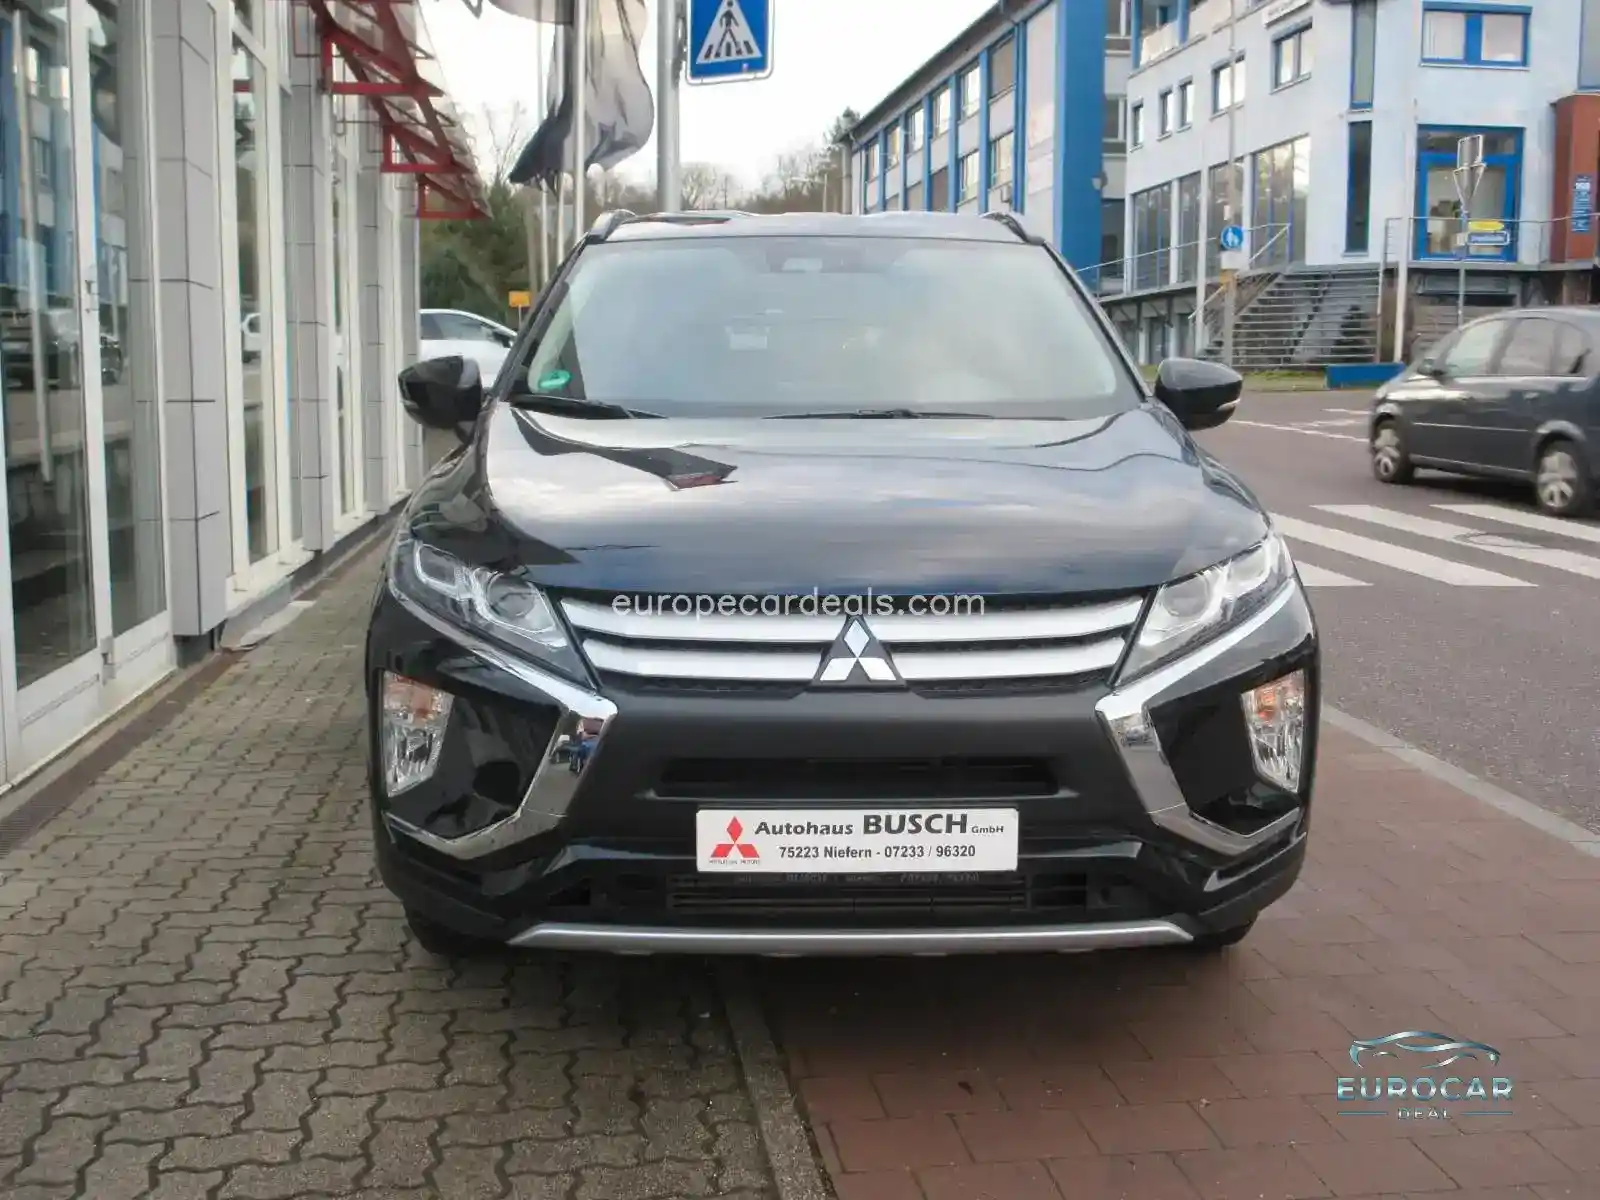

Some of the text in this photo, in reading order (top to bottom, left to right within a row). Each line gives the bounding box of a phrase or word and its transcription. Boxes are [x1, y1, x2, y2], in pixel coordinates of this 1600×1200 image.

[754, 813, 1004, 836] Autohaus BUSCH GmbH
[779, 846, 819, 859] 75223
[824, 846, 872, 859] Niefern
[884, 845, 924, 858] 07233
[936, 845, 976, 858] 96320
